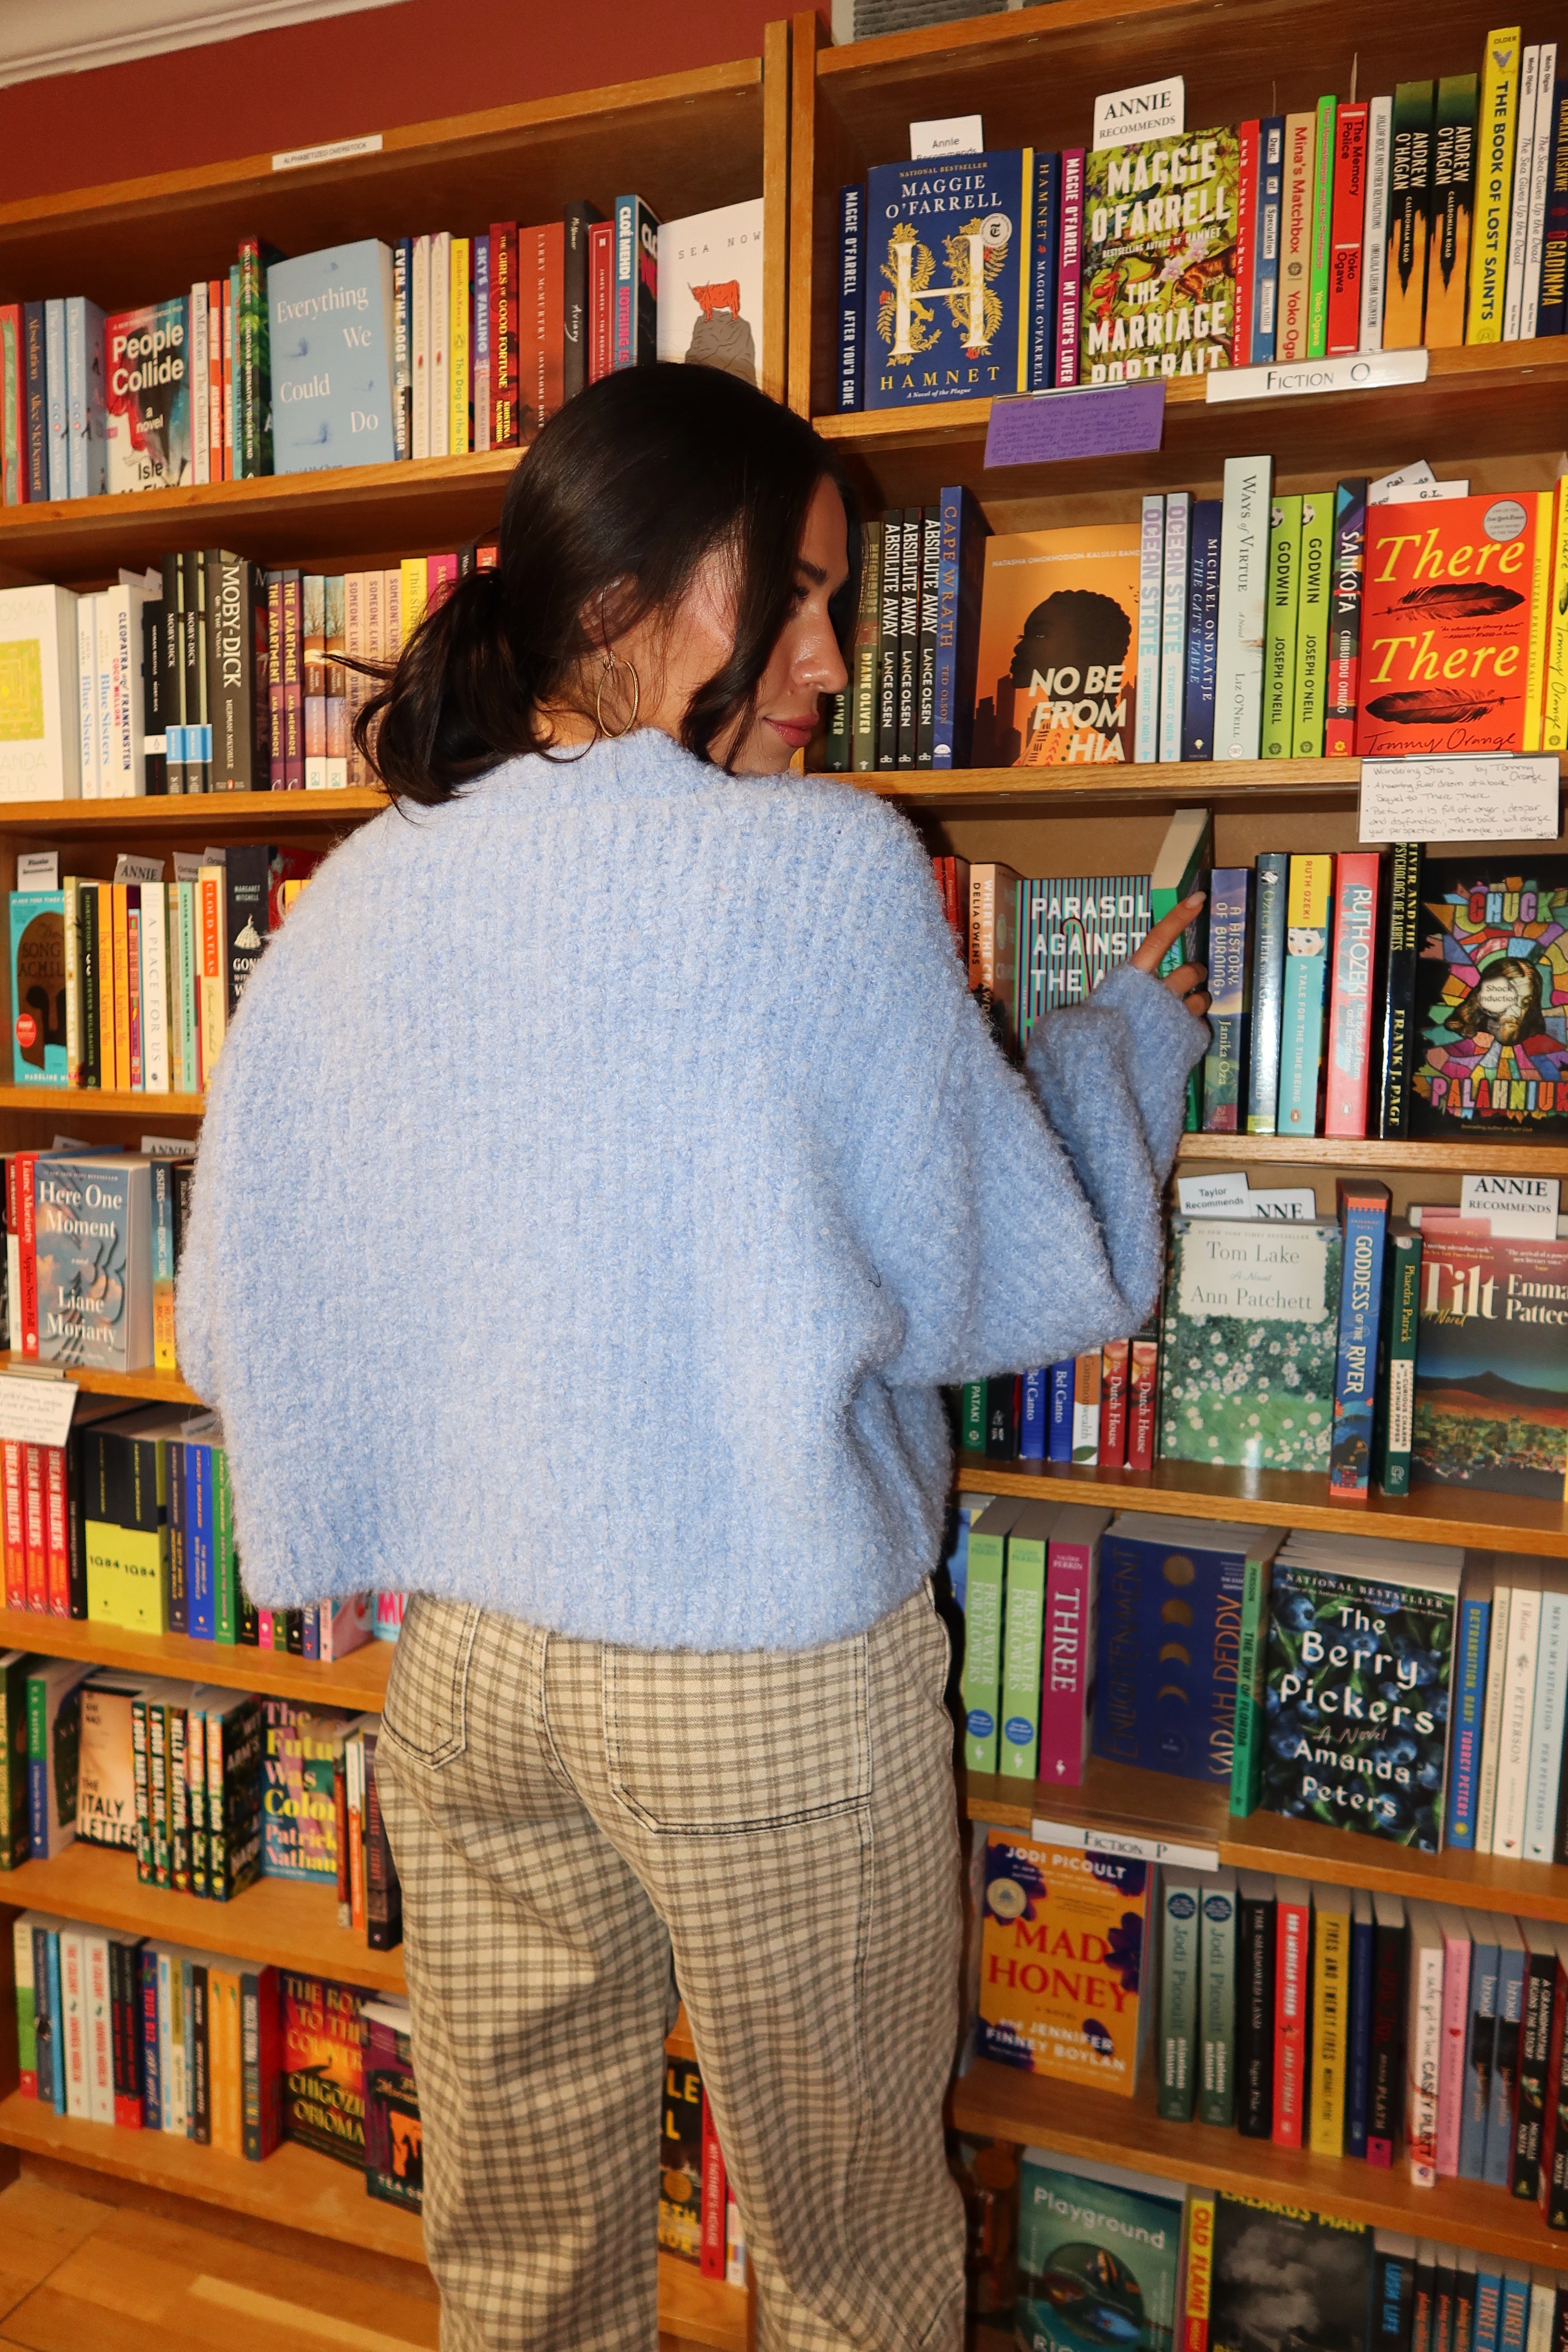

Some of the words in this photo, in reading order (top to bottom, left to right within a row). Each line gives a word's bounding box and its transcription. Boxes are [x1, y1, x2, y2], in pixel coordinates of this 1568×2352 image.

[1104, 90, 1173, 121] ANNIE
[1494, 81, 1509, 117] THE
[933, 137, 959, 148] Annie
[1099, 116, 1176, 139] RECOMMENDS
[1342, 123, 1352, 160] Police
[1353, 119, 1364, 142] The
[1491, 121, 1507, 173] BOOK
[940, 162, 988, 173] BESTSELLER
[1107, 141, 1217, 196] MAGGIE
[1293, 126, 1307, 173] Mina's
[1394, 133, 1410, 191] O'HAGAN
[1411, 132, 1428, 188] ANDREW
[902, 174, 986, 198] MAGGIE
[1063, 158, 1080, 202] MAGGIE
[1350, 145, 1364, 196] Memory
[885, 193, 1002, 219] O'FARRELL
[1092, 186, 1232, 243] O'FARRELL
[1290, 174, 1306, 254] Matchbox
[678, 244, 710, 259] SEA
[727, 232, 762, 246] NOW
[1063, 205, 1078, 267] O'FARRELL
[1185, 227, 1221, 243] HAMNET
[1486, 206, 1501, 250] LOST
[619, 239, 631, 280] MEHDI
[1336, 251, 1347, 294] Ogawa
[1348, 251, 1357, 280] Yoko
[277, 285, 369, 324] Everything
[1064, 280, 1076, 294] MY
[1127, 279, 1160, 306] THE
[1481, 257, 1499, 320] SAINTS
[499, 298, 507, 332] GOOD
[1287, 291, 1300, 325] Yoko
[113, 322, 184, 363] People
[343, 328, 372, 348] We
[1088, 301, 1227, 355] MARRIAGE
[112, 357, 184, 397] Collide
[498, 333, 507, 389] FORTUNE
[881, 365, 1000, 391] HAMNET
[1060, 345, 1074, 384] LOVER
[281, 374, 331, 404] Could
[136, 414, 163, 433] novel
[351, 410, 378, 434] Do
[138, 460, 163, 481] Isle
[943, 505, 957, 561] CAPE
[1167, 505, 1185, 577] OCEAN
[883, 524, 900, 592] ABSOLUTE
[1306, 537, 1322, 603] GODWIN
[1338, 531, 1359, 614] SANKOFA
[1374, 527, 1525, 582] There
[285, 582, 295, 606] THE
[940, 568, 956, 647] WRATH
[221, 566, 242, 688] MOBY-DICK
[883, 597, 898, 637] AWAY
[1164, 585, 1184, 654] STATE
[284, 609, 296, 683] APARTMENT
[1305, 634, 1316, 676] JOSEPH
[1340, 630, 1351, 678] CHIBUNDU
[1370, 629, 1520, 683] There
[1028, 667, 1081, 696] NO
[1085, 665, 1125, 694] BE
[1032, 698, 1127, 730] FROM
[1303, 679, 1315, 723] O'NEILL
[1068, 732, 1126, 762] HIA
[1364, 731, 1442, 754] Tommy
[1448, 729, 1516, 750] Orange
[1304, 860, 1312, 888] RUTH
[972, 882, 980, 917] DELIA
[1032, 895, 1151, 920] PARASOL
[1303, 891, 1311, 920] OZEKI
[1468, 891, 1556, 924] CHUCK
[972, 922, 980, 965] OWENS
[1033, 932, 1147, 956] AGAINST
[1213, 926, 1227, 988] BURNING
[1228, 922, 1242, 985] HISTORY
[1031, 969, 1082, 992] THE
[1486, 984, 1512, 992] Shock
[1393, 1009, 1405, 1066] FRANK
[1389, 1084, 1401, 1127] PAGE
[1432, 1077, 1568, 1112] PALAHNIUK
[39, 1181, 80, 1204] Here
[86, 1184, 122, 1210] One
[1185, 1196, 1244, 1210] Recommends
[1199, 1187, 1227, 1198] Taylor
[1474, 1178, 1547, 1196] ANNIE
[46, 1210, 116, 1239] Moment
[1469, 1200, 1552, 1214] RECOMMENDS
[1207, 1241, 1247, 1262] Tom
[1257, 1244, 1300, 1264] Lake
[1352, 1235, 1373, 1311] GODDESS
[1421, 1262, 1499, 1321] Tilt
[1507, 1273, 1568, 1301] Emma
[59, 1286, 104, 1314] Liane
[1191, 1286, 1228, 1305] Ann
[1237, 1289, 1313, 1311] Patchett
[46, 1313, 115, 1349] Moriarty
[1343, 1345, 1366, 1394] RIVER
[1338, 1606, 1387, 1635] The
[1050, 1588, 1081, 1693] THREE
[1302, 1631, 1418, 1690] Berry
[1280, 1674, 1435, 1734] Pickers
[1293, 1740, 1410, 1784] Amanda
[1302, 1776, 1397, 1818] Peters
[1005, 1847, 1047, 1864] JODI
[1053, 1853, 1126, 1879] PICOULT
[1156, 1844, 1167, 1858] P
[1015, 1919, 1108, 1964] MAD
[989, 1954, 1131, 2013] HONEY
[1034, 2186, 1167, 2250] Playground
